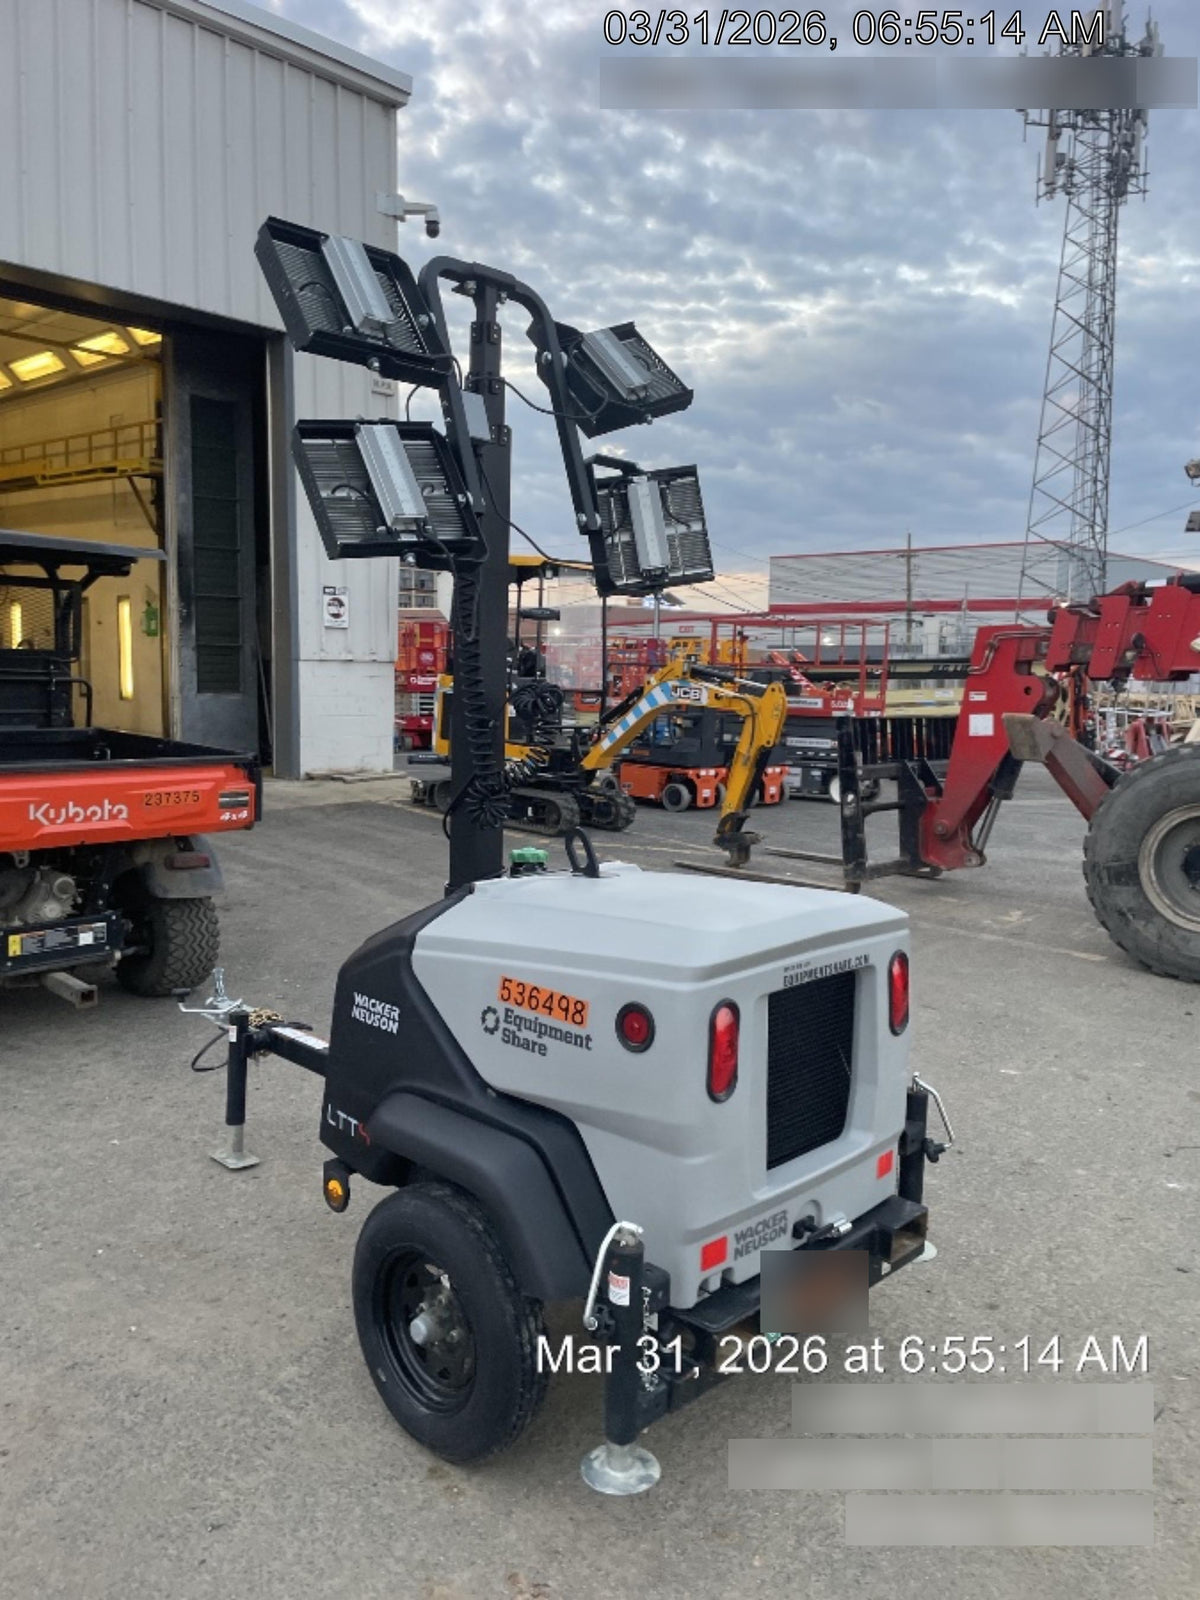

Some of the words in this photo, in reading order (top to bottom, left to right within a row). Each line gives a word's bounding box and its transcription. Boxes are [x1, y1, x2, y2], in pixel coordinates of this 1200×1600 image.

[671, 685, 701, 700] JCB
[29, 798, 129, 826] Kubota
[144, 790, 200, 807] 237375
[353, 991, 400, 1021] WACKER
[500, 977, 586, 1026] 536498
[351, 1004, 399, 1035] NEUSON
[503, 1007, 593, 1051] Equipment
[501, 1027, 548, 1057] Share
[734, 1209, 788, 1245] WACKER
[734, 1225, 788, 1260] NEUSON
